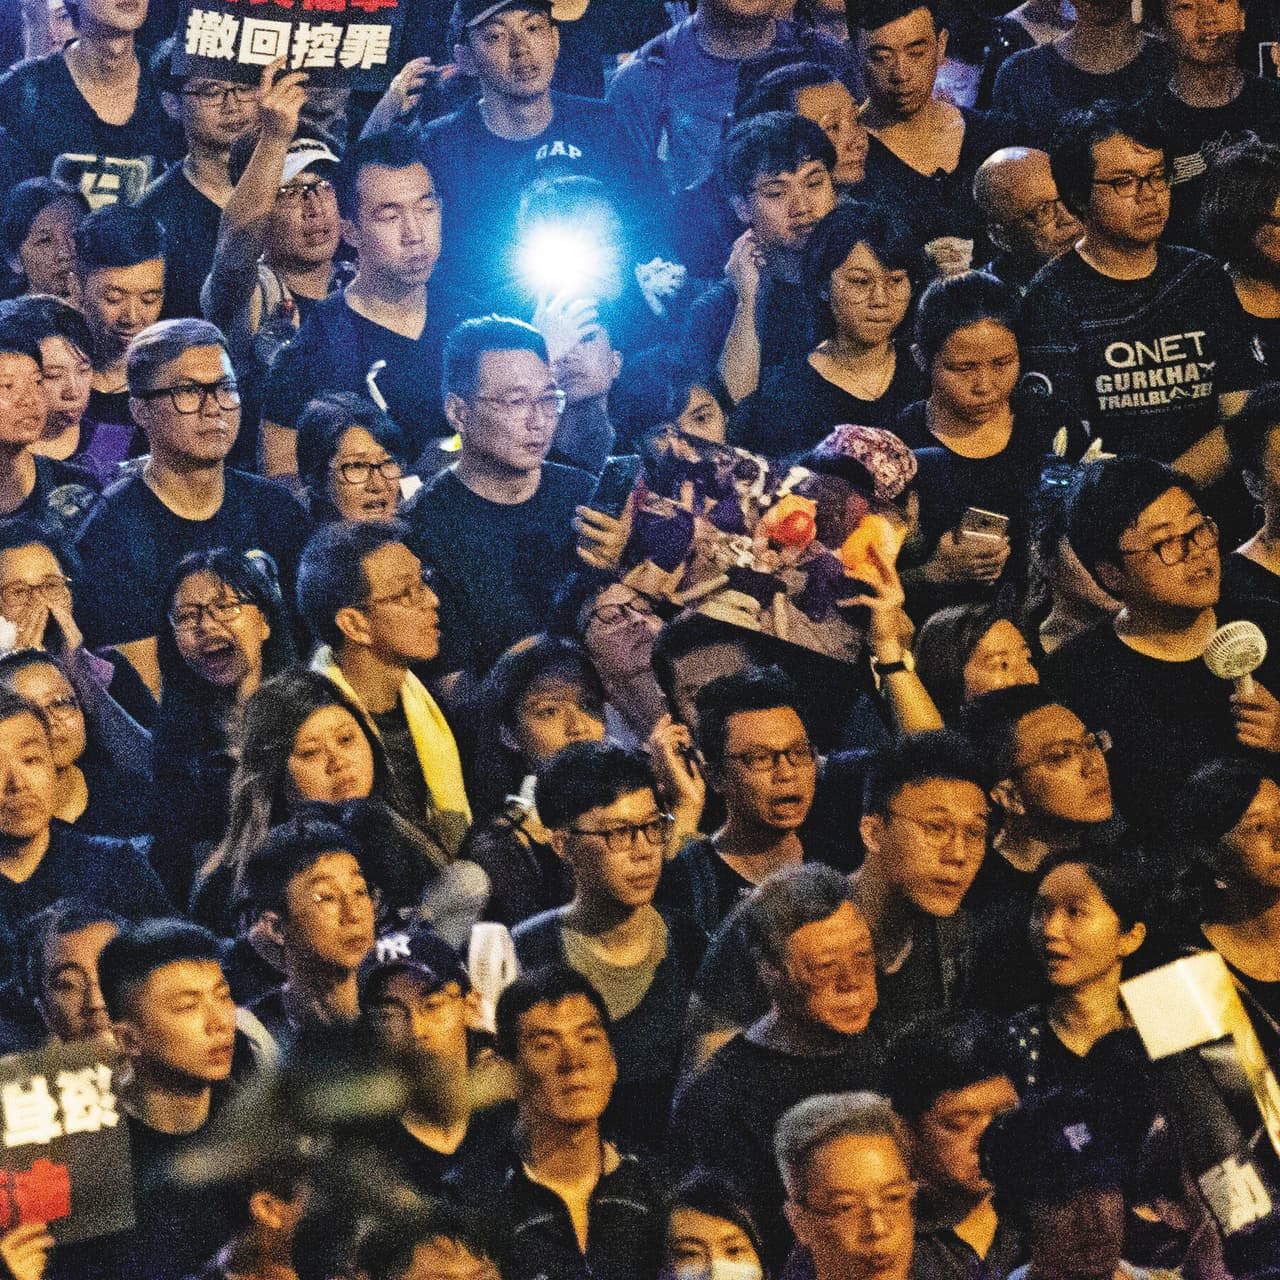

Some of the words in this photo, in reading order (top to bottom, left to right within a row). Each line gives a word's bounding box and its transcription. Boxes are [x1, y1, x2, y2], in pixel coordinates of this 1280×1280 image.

[185, 8, 392, 69] 撤回控罪
[535, 141, 582, 160] GAP
[1104, 330, 1207, 368] QNET
[1095, 362, 1200, 394] GURKHA
